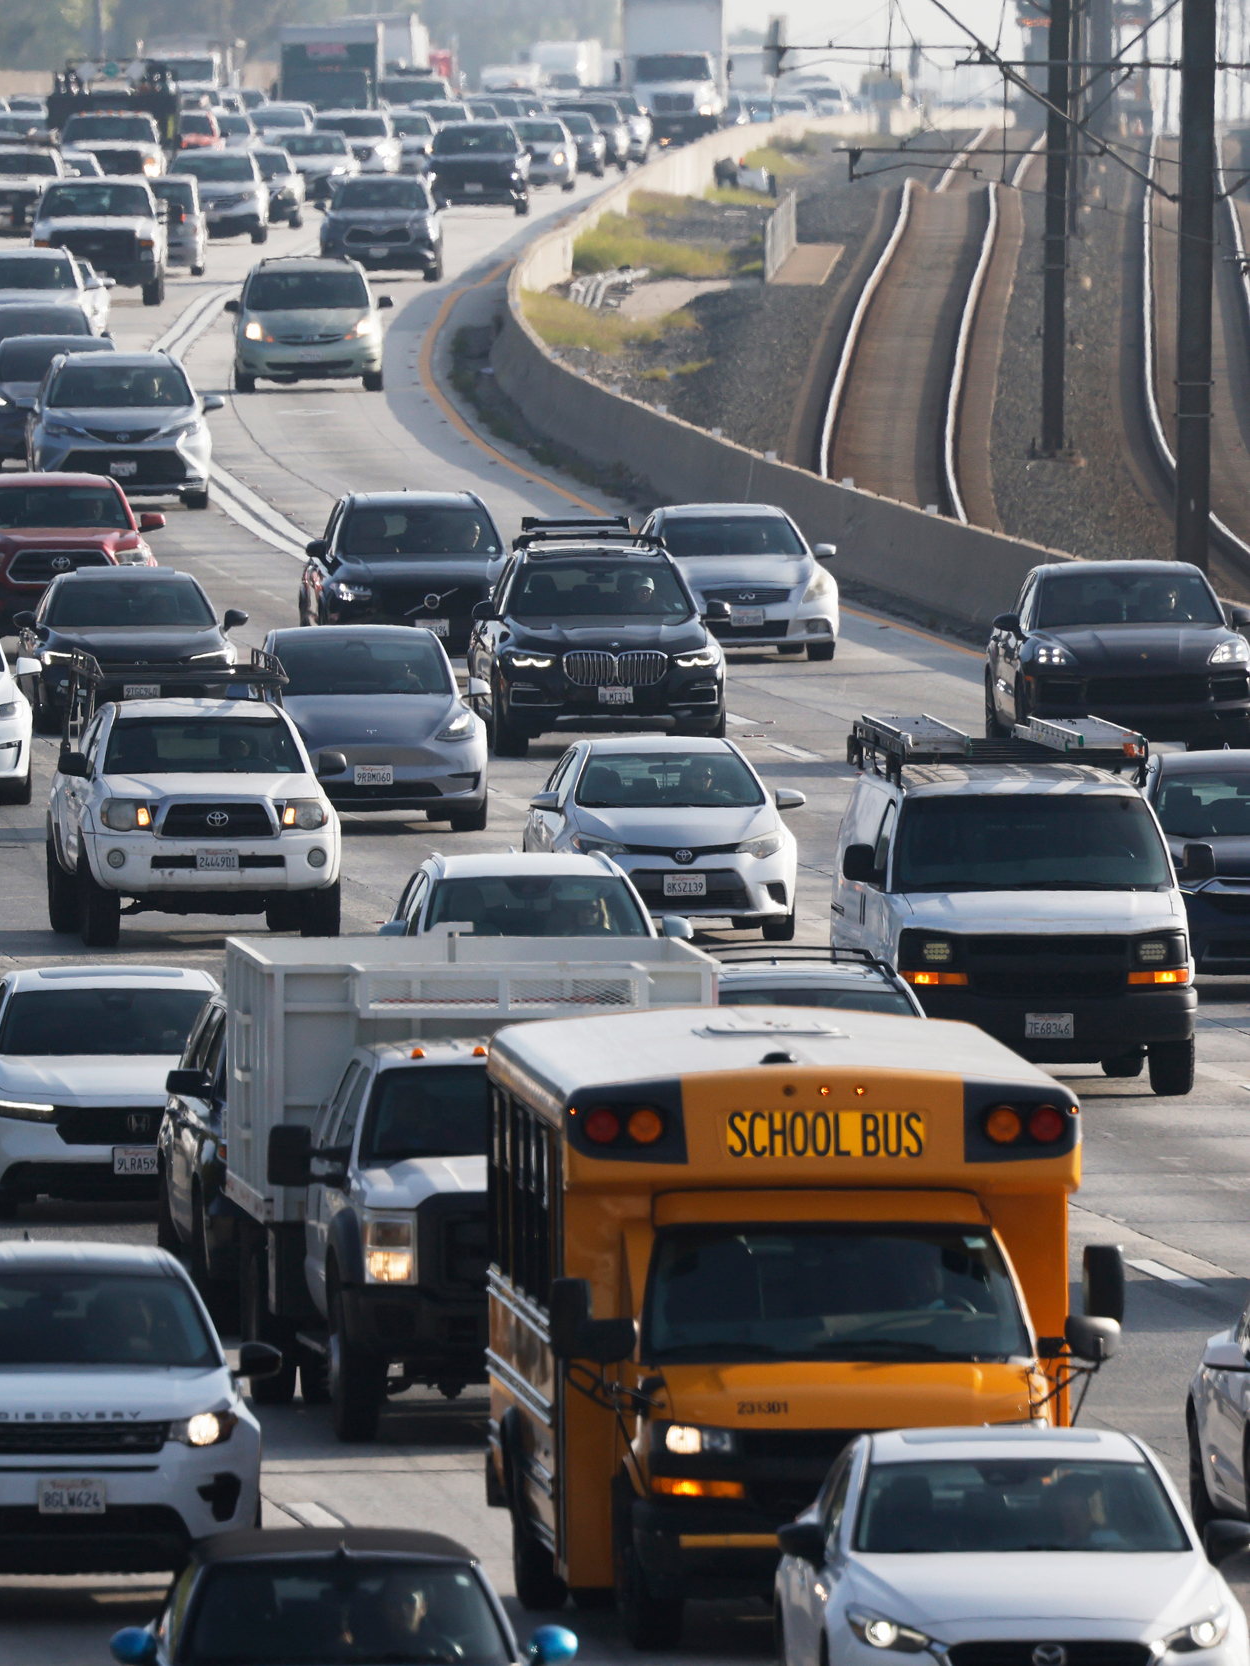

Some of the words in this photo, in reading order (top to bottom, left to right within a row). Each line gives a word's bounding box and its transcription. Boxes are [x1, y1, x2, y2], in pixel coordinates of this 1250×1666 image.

[357, 773, 390, 782] 9RBM060
[667, 883, 703, 893] 8KSZ139
[1028, 1022, 1070, 1035] 7E68346
[728, 1111, 851, 1158] SCHOOL
[861, 1112, 923, 1158] BUS
[117, 1157, 156, 1171] 9LRA59
